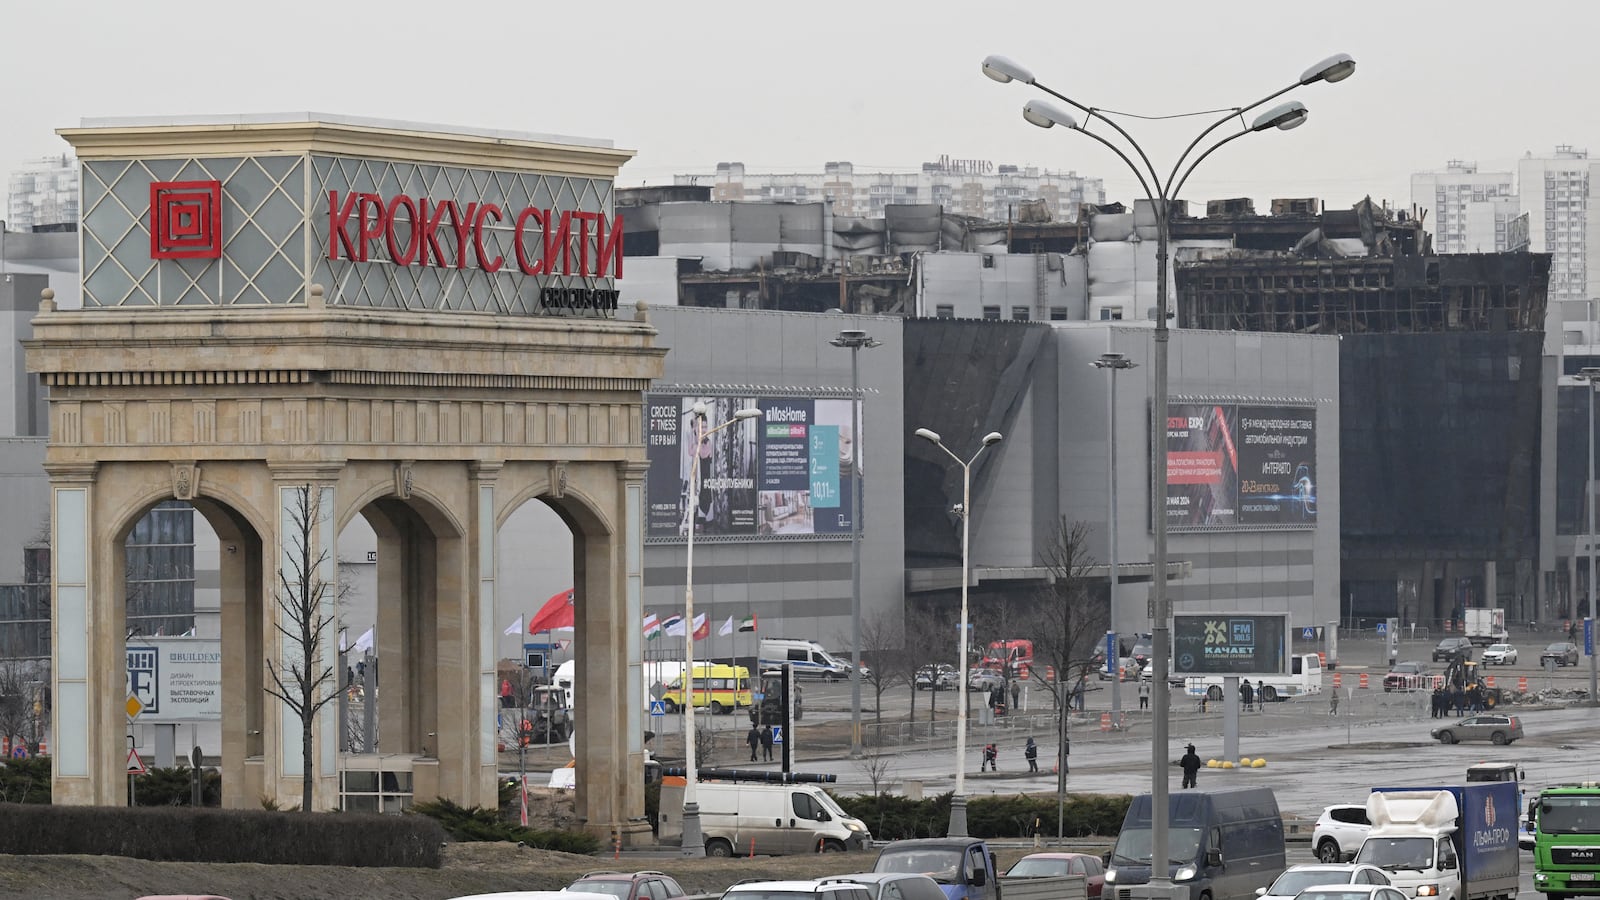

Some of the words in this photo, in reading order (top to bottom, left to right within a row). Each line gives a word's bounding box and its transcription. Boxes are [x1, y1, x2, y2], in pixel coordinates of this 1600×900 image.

[938, 154, 993, 174] Митино
[329, 190, 503, 273] КРОКУС
[515, 206, 624, 280] СИТИ
[541, 287, 592, 309] CROCUS
[593, 289, 620, 309] CITY
[651, 405, 677, 418] CROCUS
[772, 406, 806, 422] MosHome
[651, 432, 677, 446] ПЕРВЫЙ
[812, 458, 817, 474] 2
[1262, 462, 1292, 475] ИНТЕРАВТО
[704, 478, 754, 490] #ОДНОКЛУБНИКИ
[813, 481, 829, 501] 10,11
[1233, 624, 1251, 633] FM
[1233, 634, 1251, 642] 100.5
[177, 653, 221, 661] BUILDEXP
[170, 672, 194, 680] ДИЗАЙН
[170, 696, 209, 704] ЭКСПОЗИЦИЙ
[1473, 828, 1510, 846] АЛЬФА-ПРОФ
